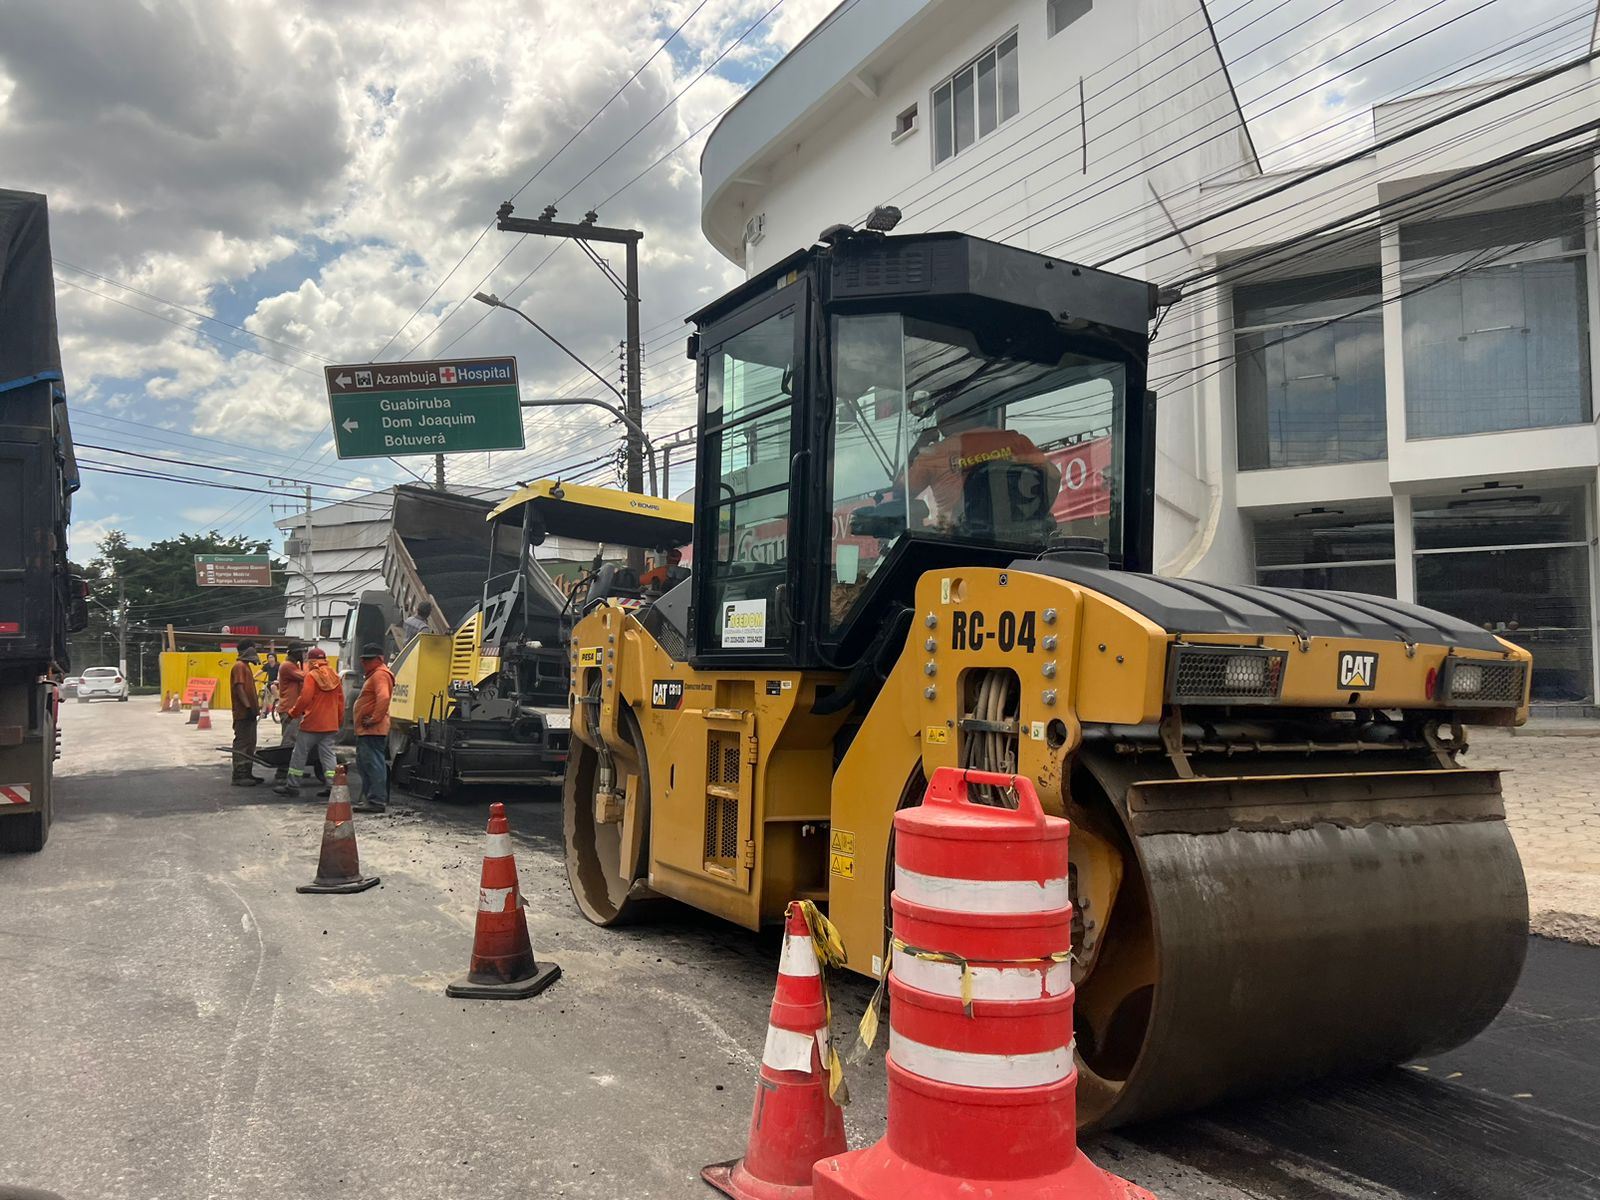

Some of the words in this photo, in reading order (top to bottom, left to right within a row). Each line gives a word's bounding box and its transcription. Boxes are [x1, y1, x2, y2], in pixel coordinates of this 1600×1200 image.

[376, 371, 437, 386] Azambuja
[458, 367, 510, 382] Hospital
[380, 397, 451, 412] Guabiruba
[382, 416, 412, 428] Dom
[418, 413, 476, 428] Joaquim
[384, 432, 446, 447] Botuverá
[951, 610, 1037, 654] RC-04
[1341, 655, 1374, 686] CAT
[653, 683, 668, 705] CAT
